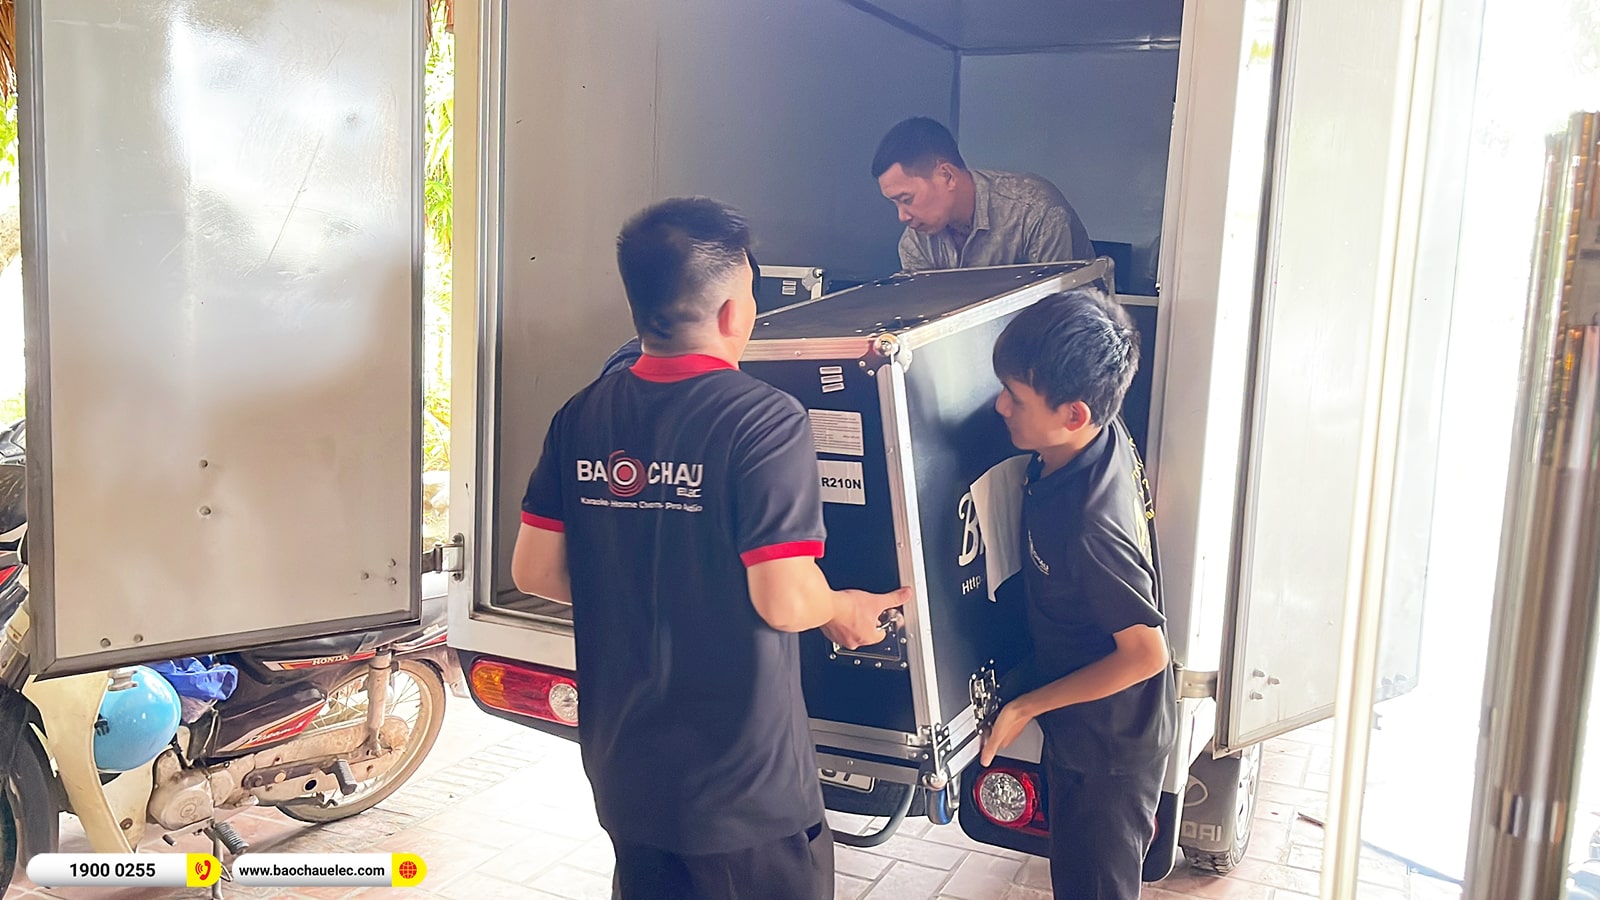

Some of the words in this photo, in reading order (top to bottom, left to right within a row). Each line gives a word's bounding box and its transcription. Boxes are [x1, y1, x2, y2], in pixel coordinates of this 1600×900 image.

[576, 459, 638, 486] BAO
[647, 461, 703, 487] CHAU
[821, 477, 862, 490] R210N
[312, 654, 349, 666] HONDA
